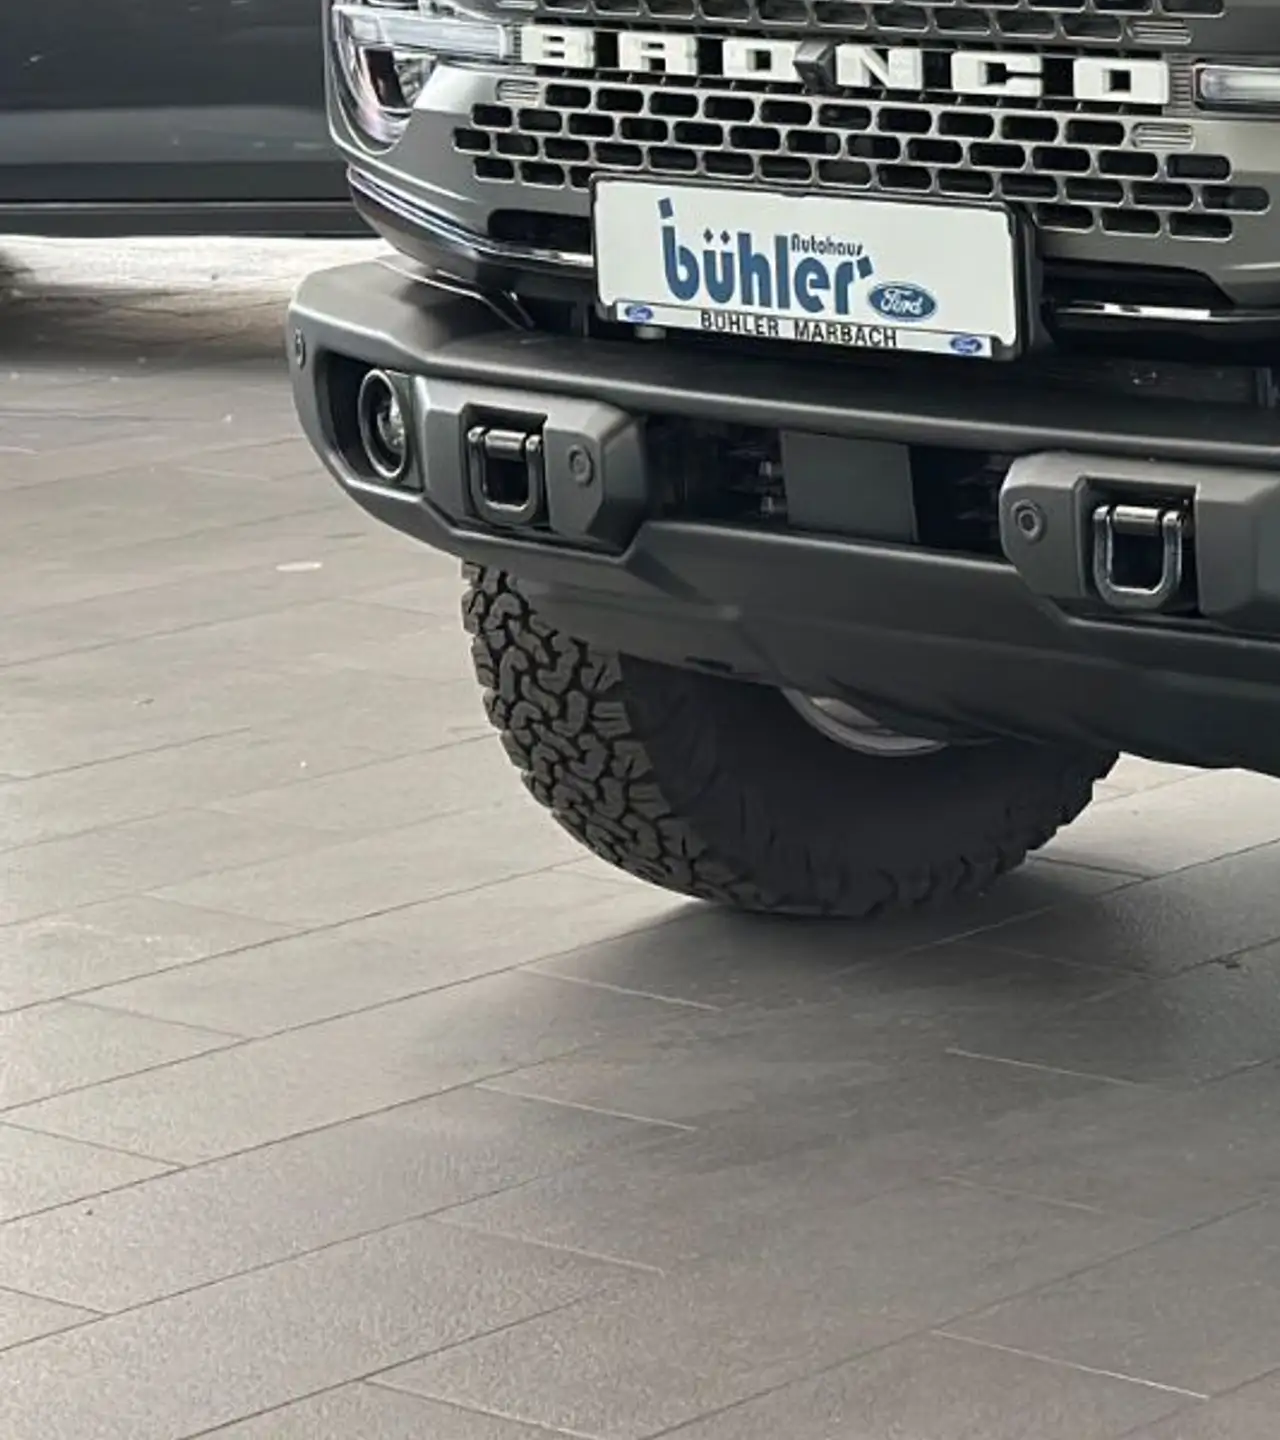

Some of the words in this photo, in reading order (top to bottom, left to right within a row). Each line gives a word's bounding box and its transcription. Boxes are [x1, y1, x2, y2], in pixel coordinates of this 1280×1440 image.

[519, 23, 1171, 105] BRONCO
[658, 197, 874, 315] bühler
[790, 232, 864, 257] Autohaus
[793, 319, 898, 348] MARBACH
